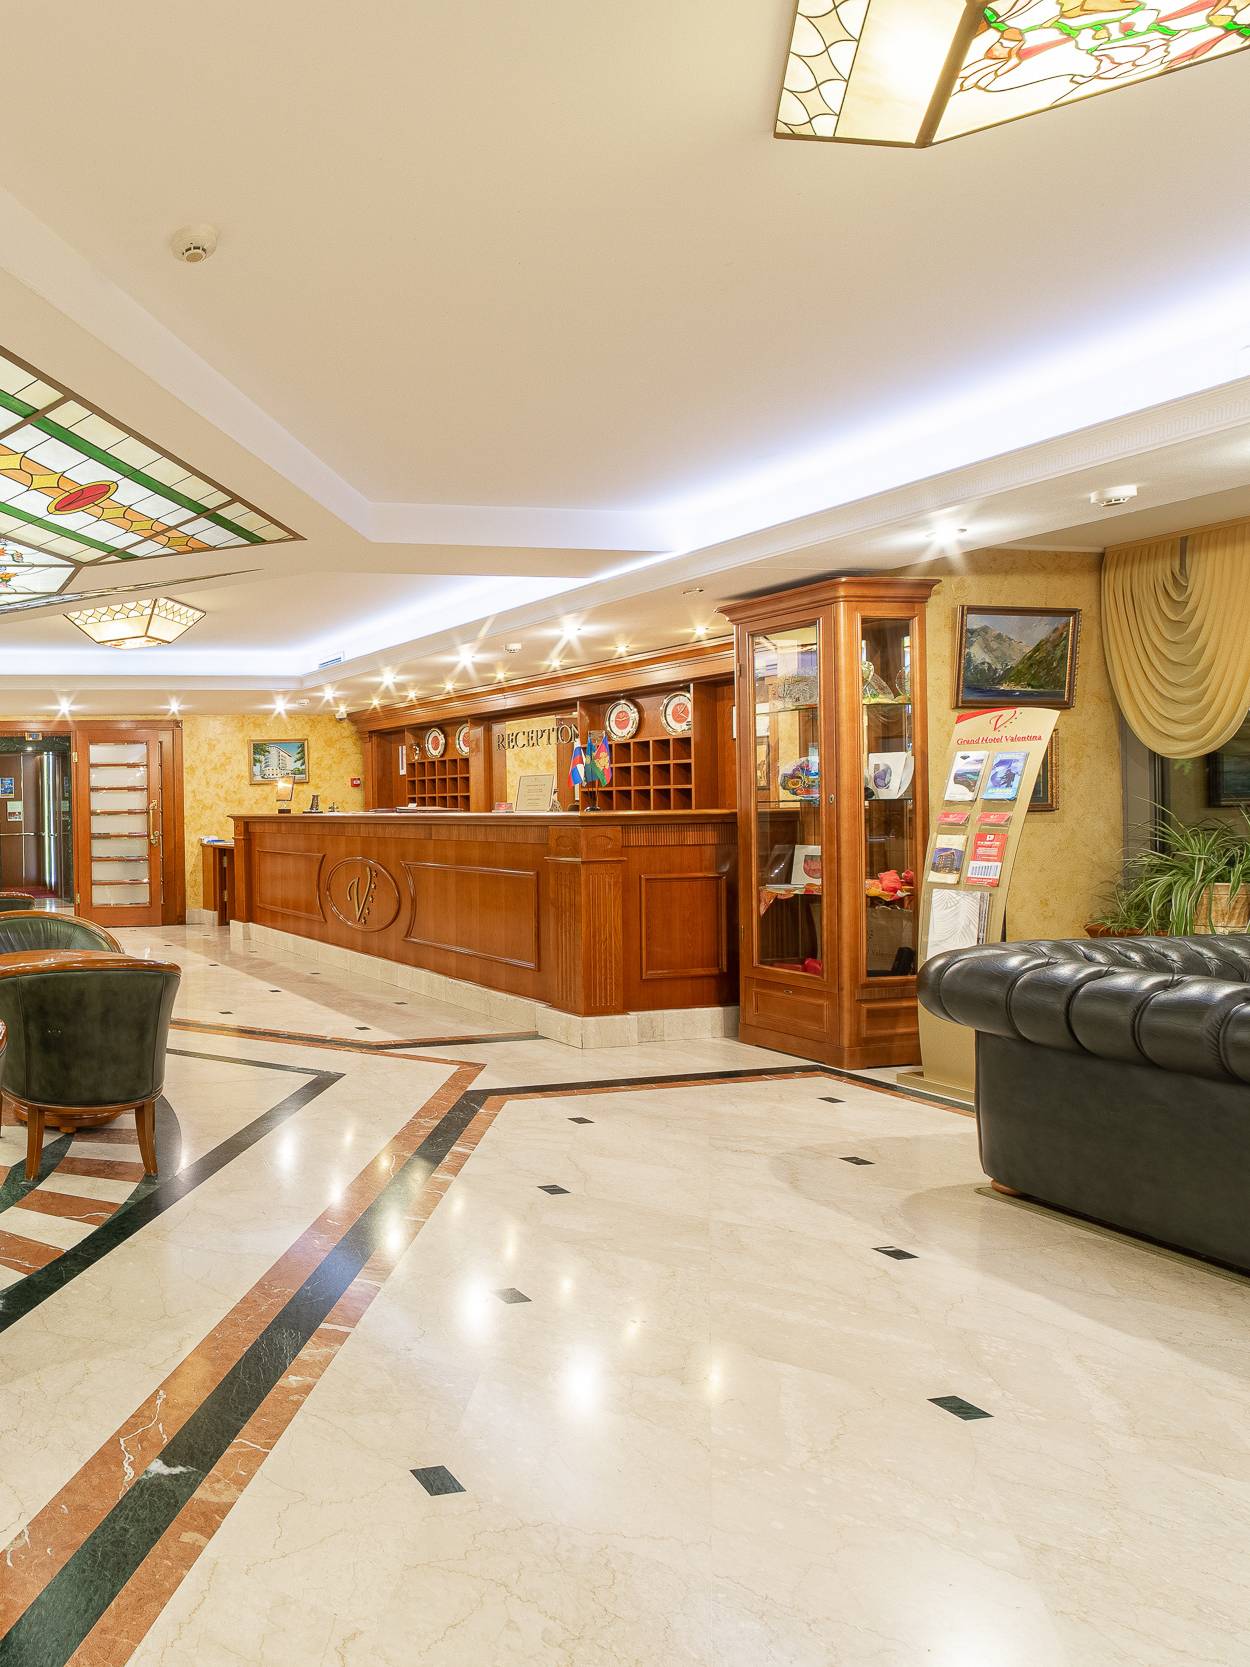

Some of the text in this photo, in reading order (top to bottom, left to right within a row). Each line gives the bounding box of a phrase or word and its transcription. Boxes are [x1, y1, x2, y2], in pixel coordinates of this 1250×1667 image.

[956, 734, 1043, 745] Grand Hotel Valentina
